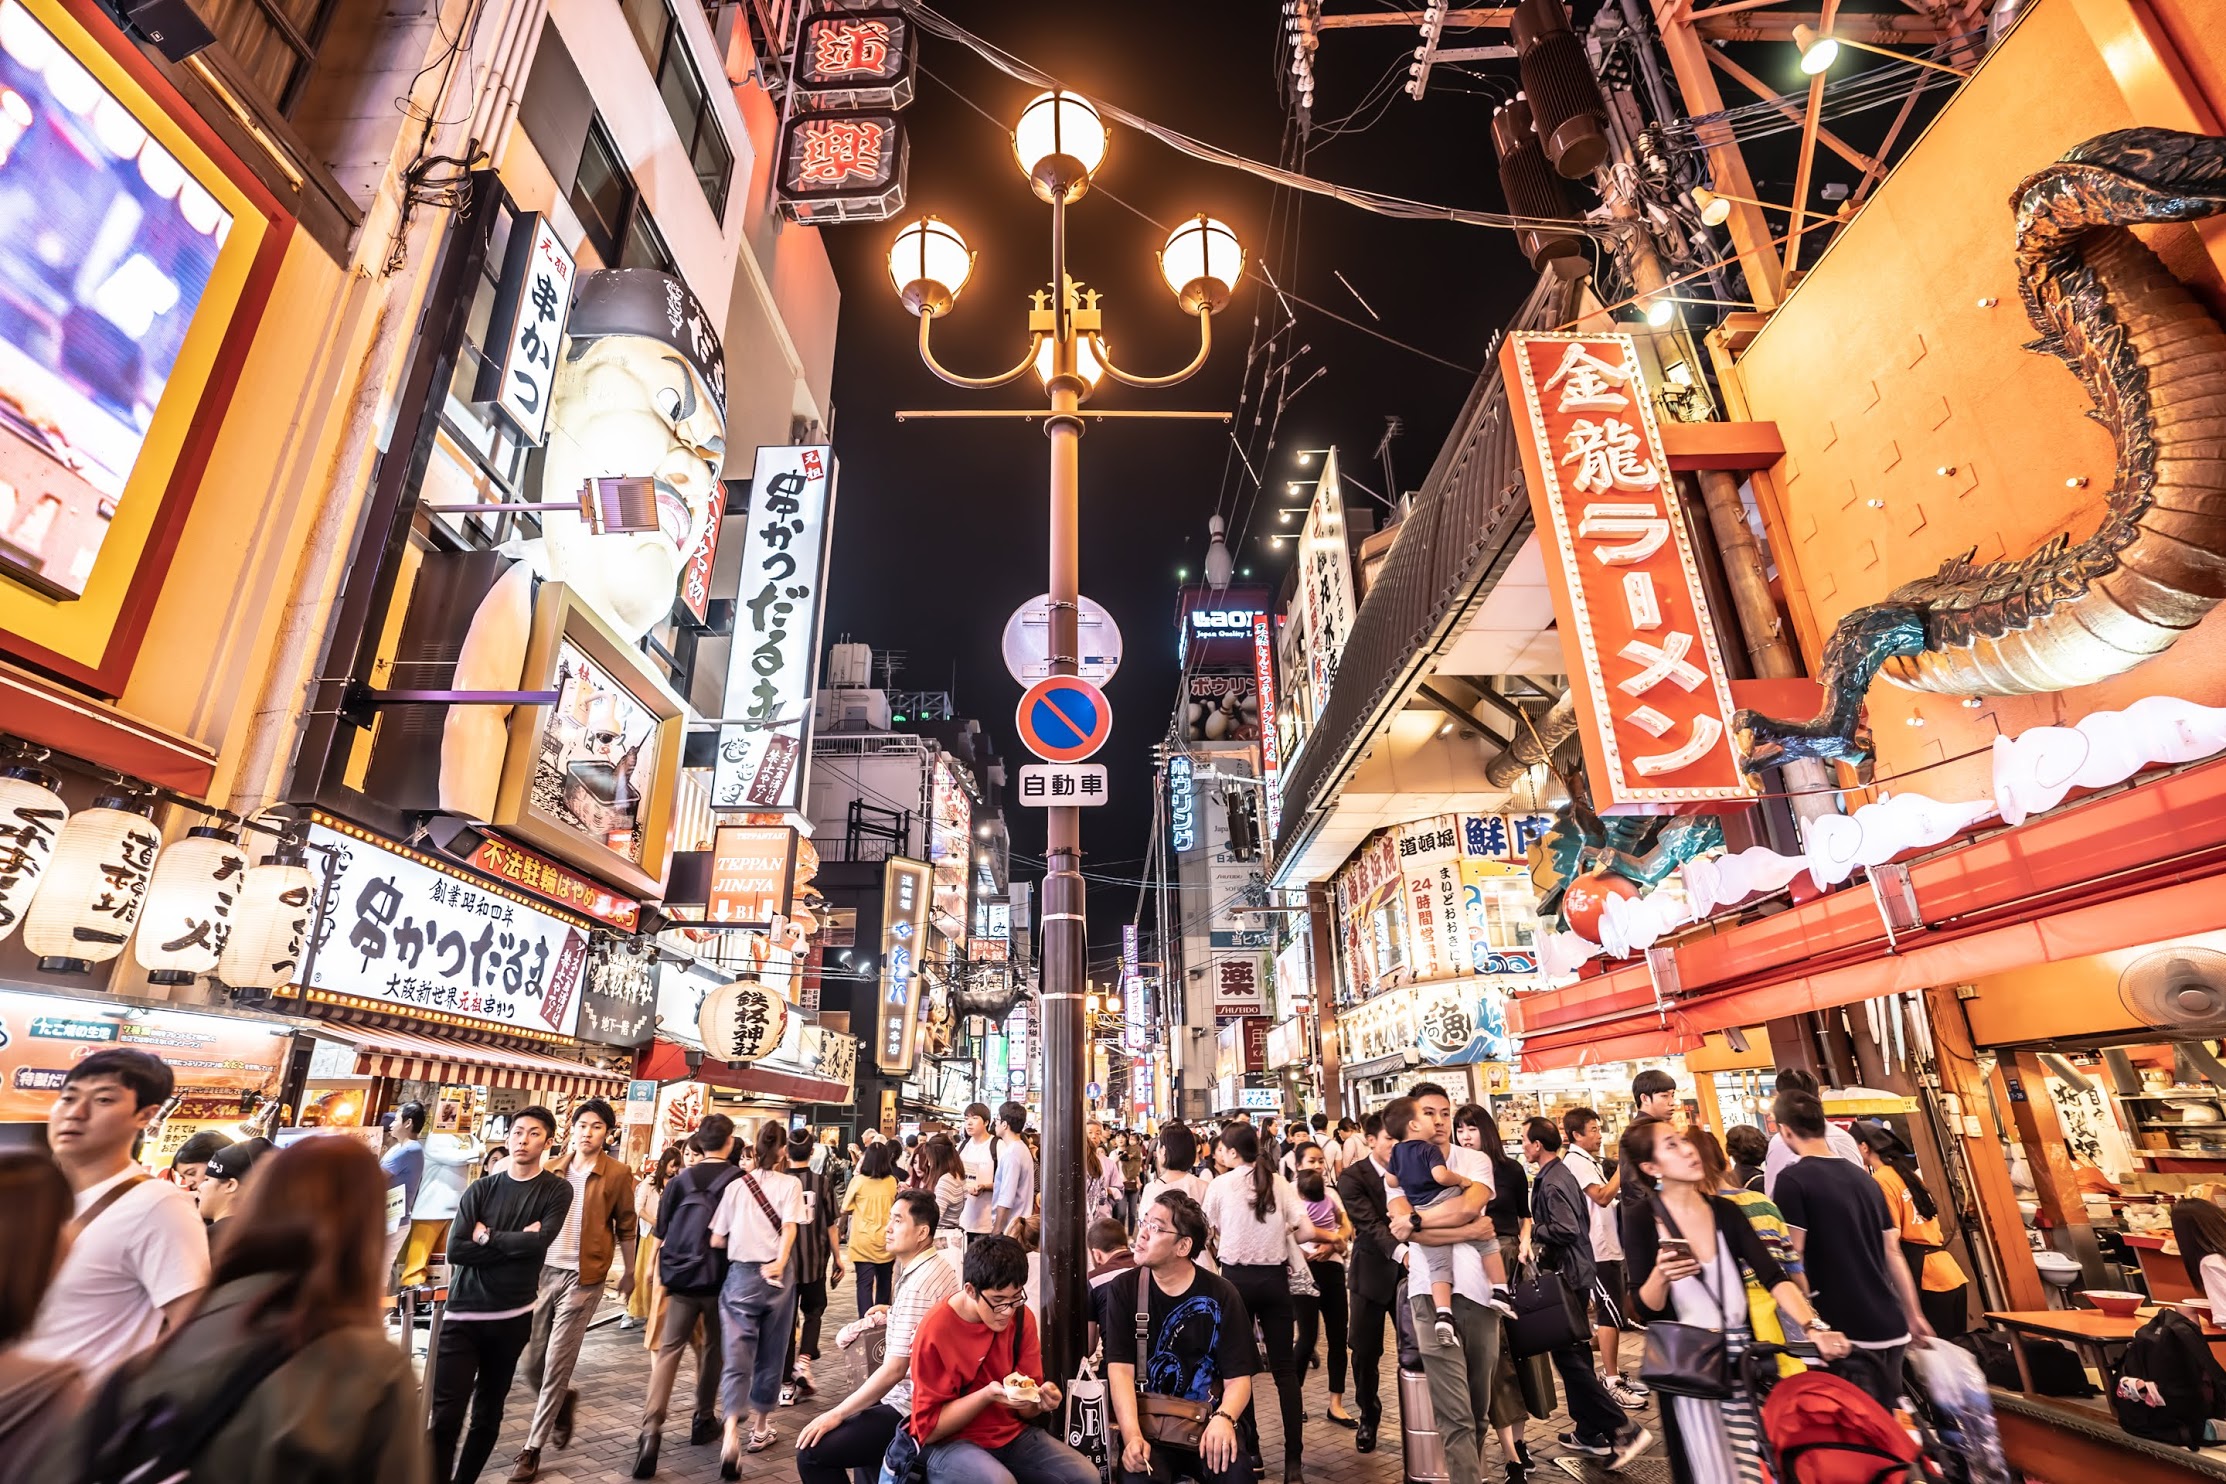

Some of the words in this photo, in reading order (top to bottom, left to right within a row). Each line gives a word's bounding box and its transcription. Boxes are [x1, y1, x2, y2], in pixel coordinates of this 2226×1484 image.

[514, 273, 560, 414] 串かつ
[803, 451, 823, 480] 元祖
[1543, 342, 1724, 777] 金龍ラーメン
[746, 469, 810, 733] 串かつだるま
[1196, 631, 1217, 639] Japan
[1218, 630, 1245, 639] Quality
[1024, 774, 1103, 796] 自動車
[736, 832, 786, 841] TEPPANYAKI
[1400, 828, 1455, 857] 道頓堀
[717, 857, 785, 871] TEPPAN
[713, 878, 775, 892] JINJYA
[429, 877, 515, 928] 創業昭和四年
[735, 905, 754, 920] B1
[1439, 867, 1461, 962] まいどおおきに
[349, 876, 550, 1000] 串かつだるま
[1411, 877, 1439, 977] 24時間営業中
[1221, 961, 1255, 996] 薬
[382, 974, 516, 1019] 大阪新世界元祖串かつ
[1217, 1005, 1259, 1015] SHISEIDO
[601, 1016, 631, 1037] 地下一階
[1246, 1096, 1272, 1106] 大たこ
[1085, 1408, 1100, 1436] B
